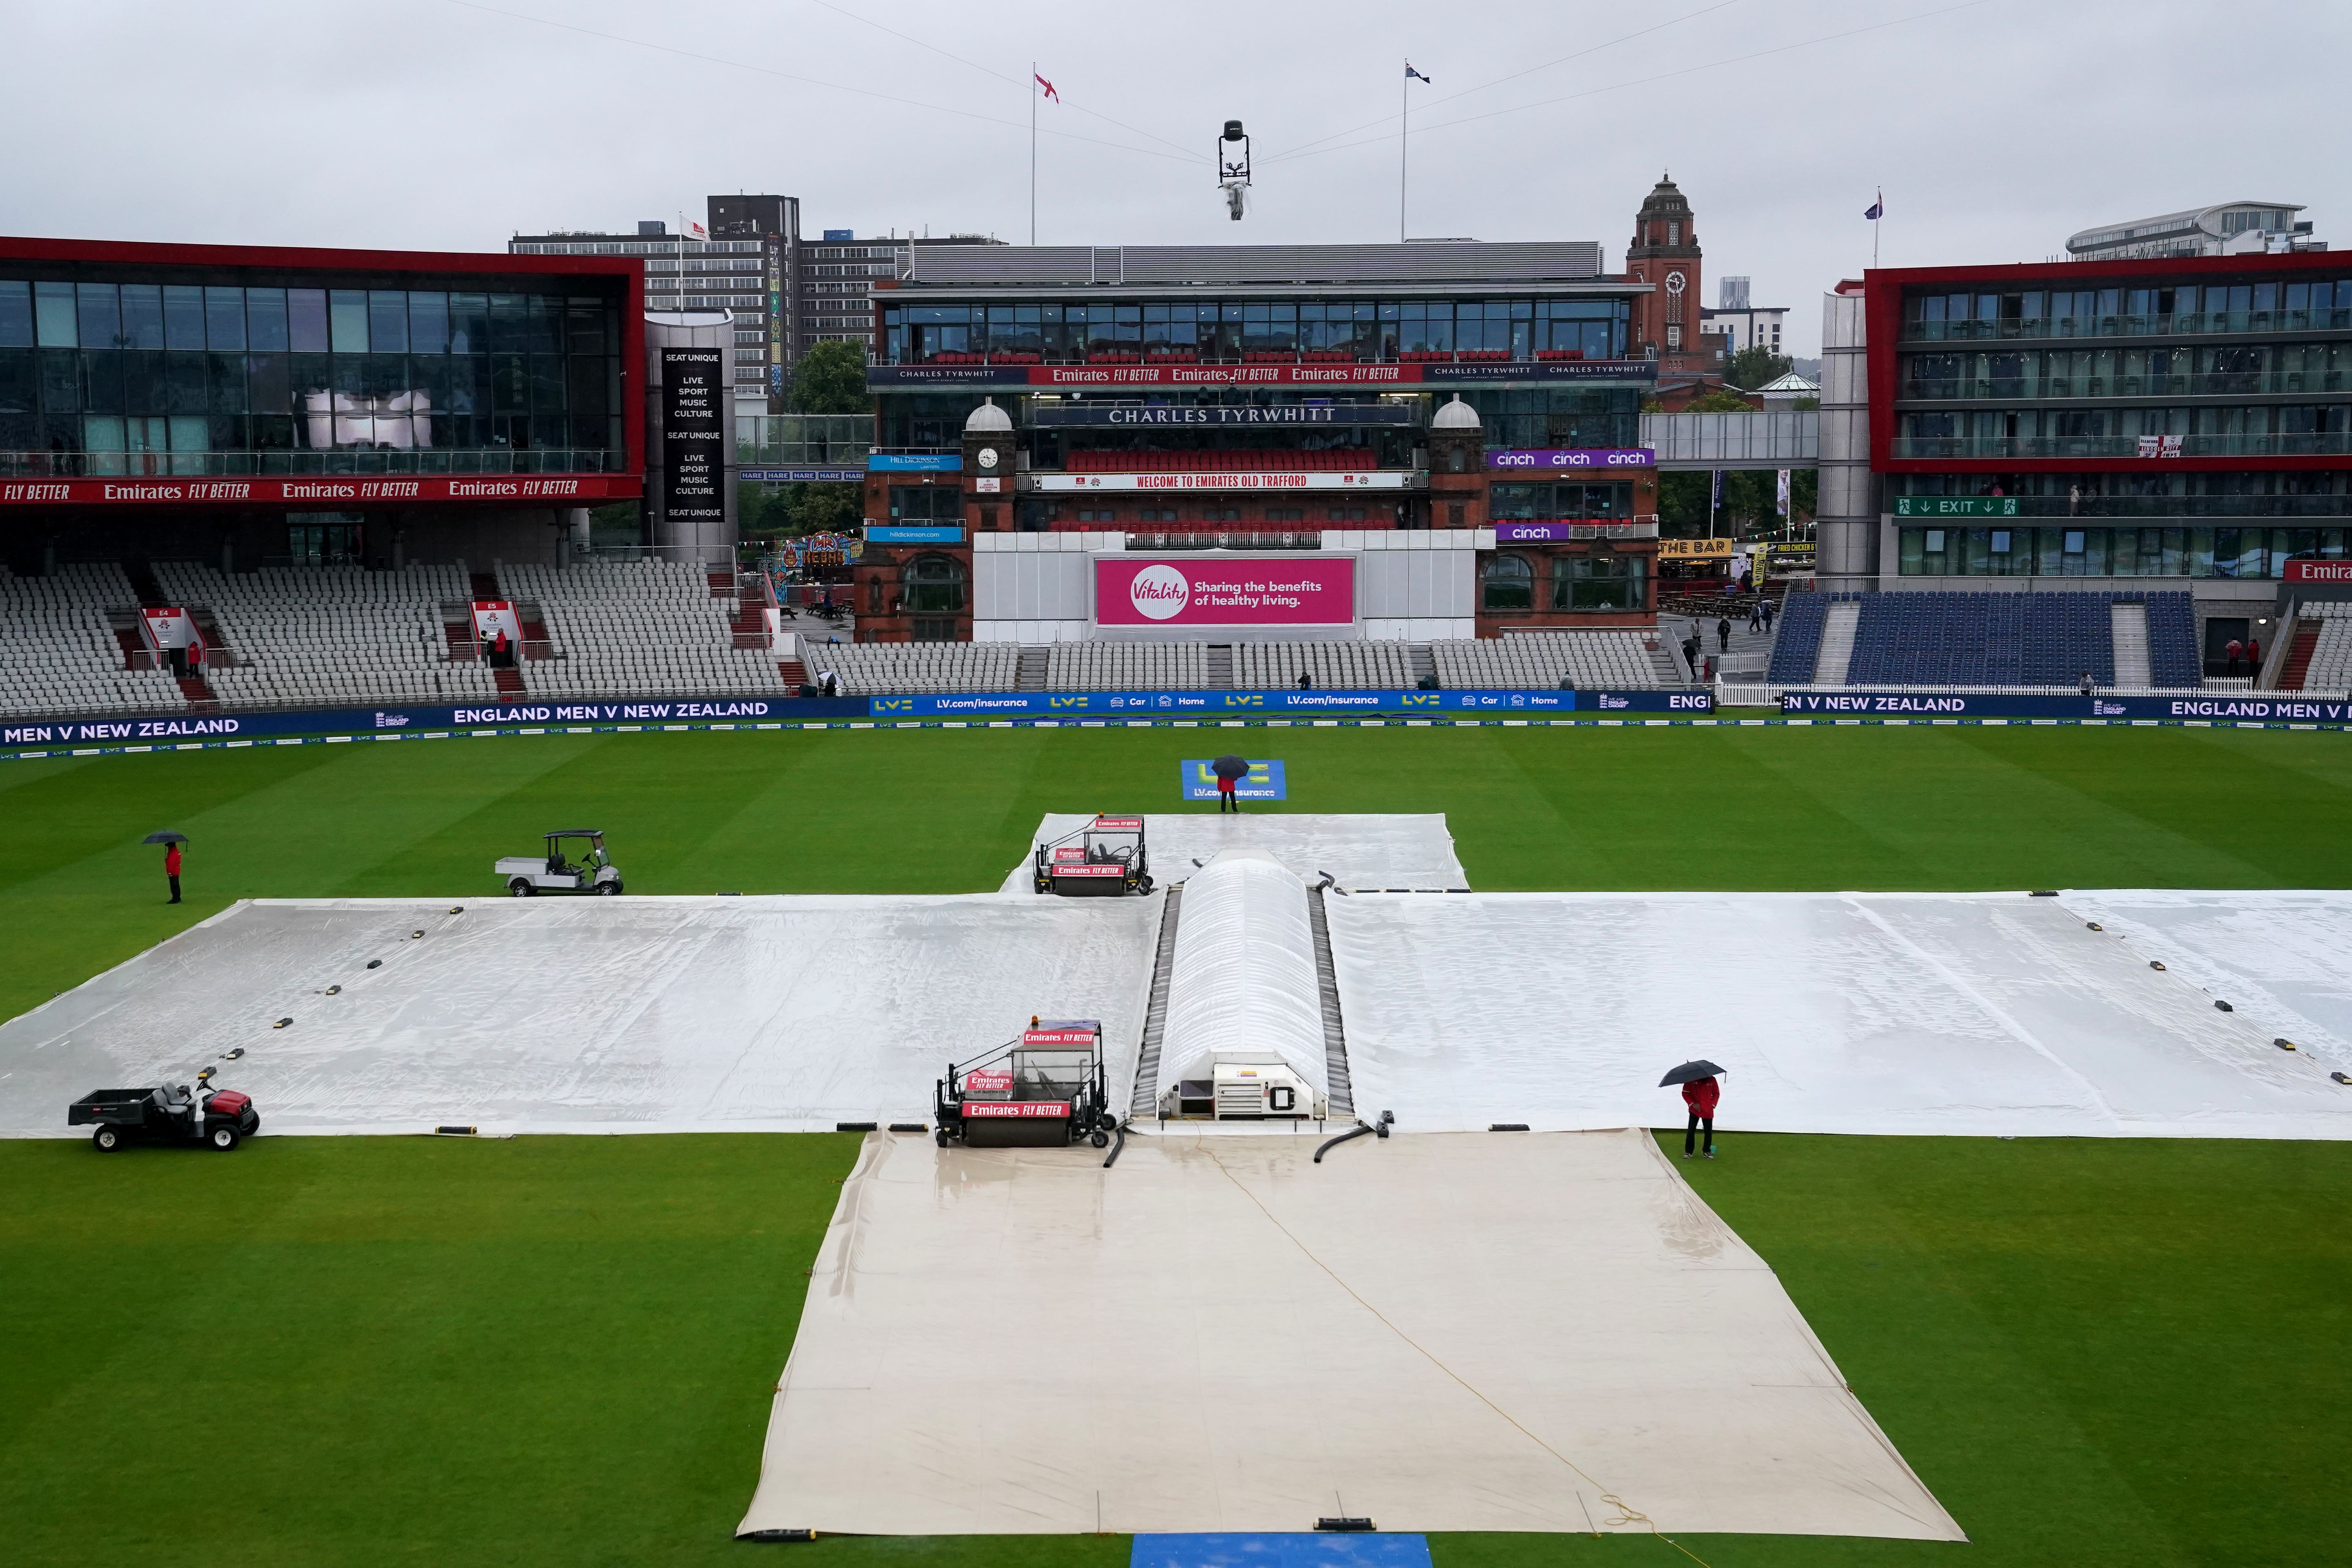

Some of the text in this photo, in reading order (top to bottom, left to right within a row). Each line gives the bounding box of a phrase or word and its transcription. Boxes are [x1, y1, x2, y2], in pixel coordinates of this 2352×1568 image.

[1053, 369, 1159, 381] Emirates FLY BETTER
[1172, 368, 1279, 381] Emirates FLY BETTER
[1292, 367, 1399, 380] Emirates FLY BETTER
[1108, 409, 1336, 423] CHARLES TYRWHITT
[1496, 451, 1535, 466] cinch
[1552, 451, 1590, 466] cinch
[1607, 450, 1645, 465] cinch
[449, 480, 578, 496] Emirates FLY BETTER
[1137, 475, 1307, 488] WELCOME TO EMIRATES OLD TRAFFORD
[4, 485, 70, 500] FLY BETTER
[104, 483, 250, 499] Emirates FLY BETTER
[282, 482, 419, 498] Emirates FLY BETTER
[1940, 501, 1974, 512] EXIT
[1512, 525, 1550, 540] cinch
[1658, 541, 1725, 554] THE BAR
[803, 550, 845, 563] KEBAB
[1755, 559, 1765, 575] MENU
[1133, 578, 1186, 606] Vitality
[1194, 580, 1322, 595] Sharing the benefits
[1194, 595, 1300, 608] of healthy living.
[875, 700, 912, 710] LV=
[937, 698, 1027, 709] LV.com/insurance
[1050, 697, 1088, 707] LV=
[1226, 695, 1263, 705] LV=
[1287, 695, 1379, 706] LV.com/insurance
[1402, 695, 1440, 705] LV=
[1670, 696, 1710, 708] ENG
[1807, 696, 1820, 709] V
[1826, 697, 1870, 710] NEW
[1875, 697, 1965, 711] ZEALAND
[454, 703, 768, 723] ENGLAND MEN V NEW ZEALAND
[2172, 701, 2269, 716] ENGLAND
[2276, 704, 2320, 718] MEN
[2327, 705, 2341, 718] V
[5, 719, 239, 743] MEN V NEW ZEALAND
[1197, 763, 1270, 784] L=
[971, 1105, 1062, 1115] Emirates FLY BETTER
